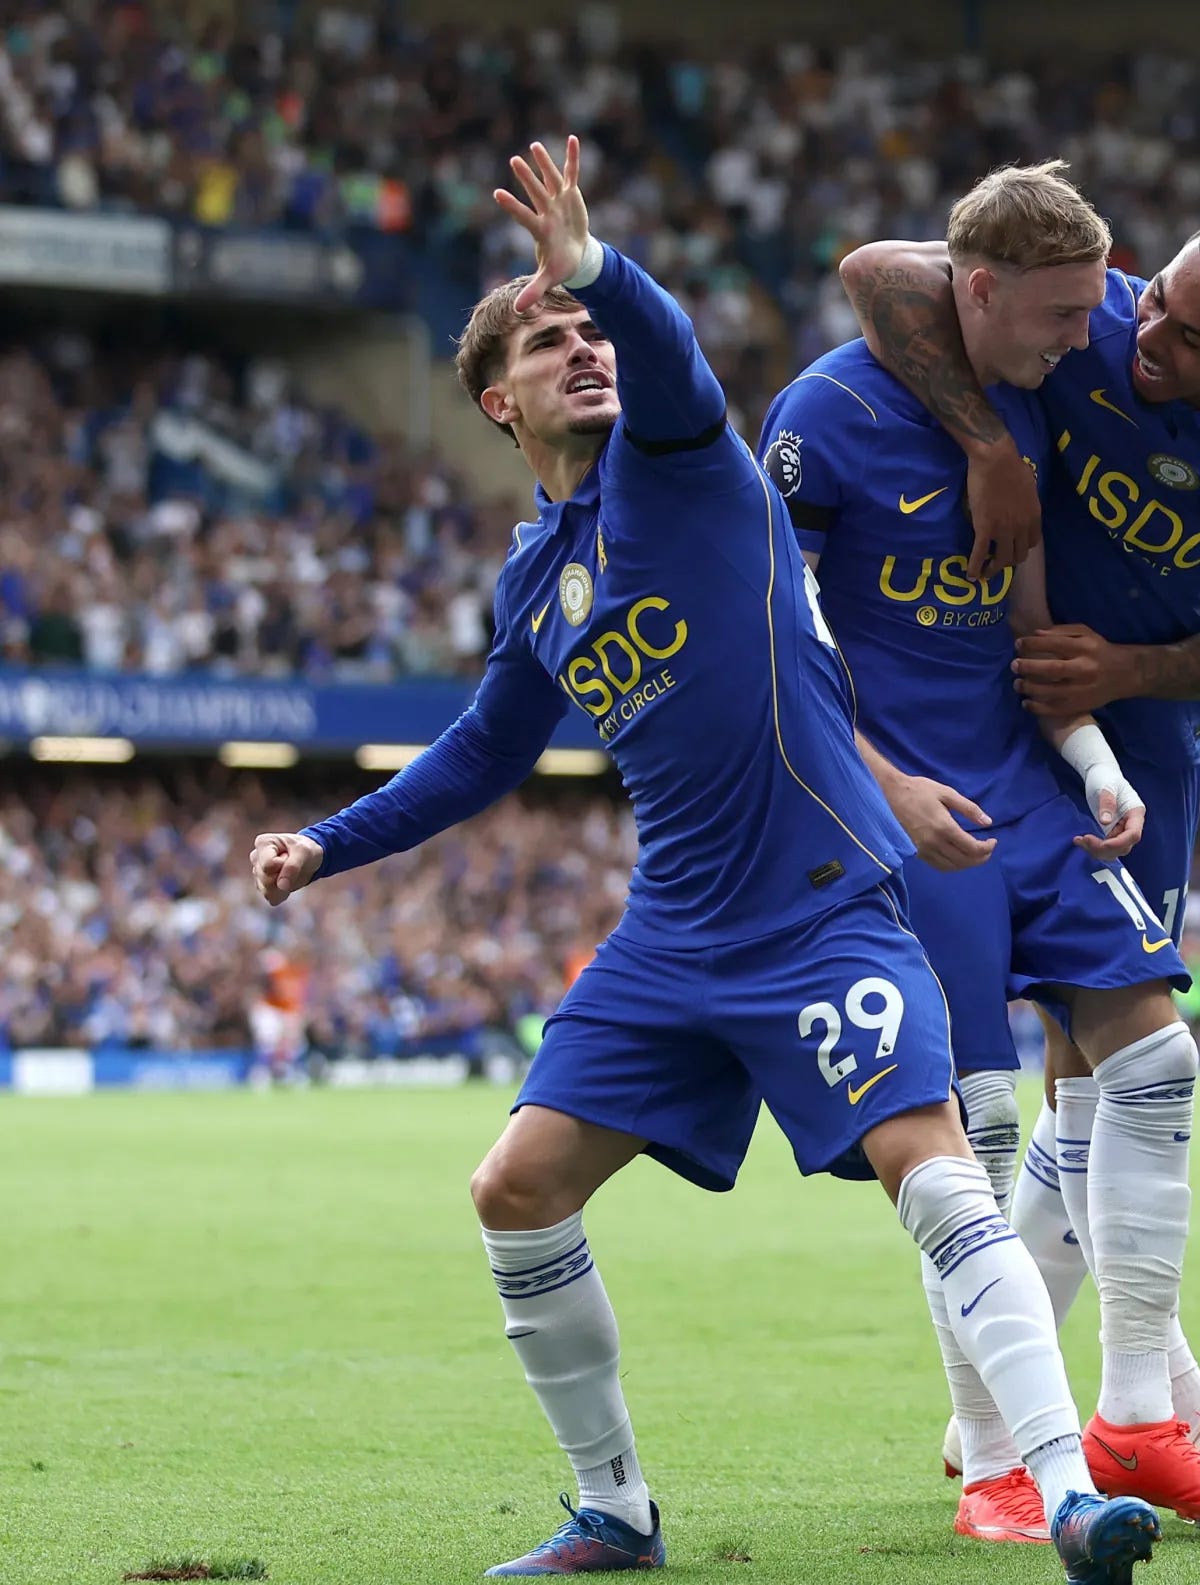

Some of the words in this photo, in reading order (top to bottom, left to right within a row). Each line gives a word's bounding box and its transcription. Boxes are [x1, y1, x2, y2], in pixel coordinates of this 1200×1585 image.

[879, 554, 1013, 606] USD
[572, 608, 585, 623] FIFA
[942, 611, 965, 627] BY
[604, 711, 621, 735] BY
[620, 668, 677, 721] CIRCLE
[798, 976, 905, 1089] 29
